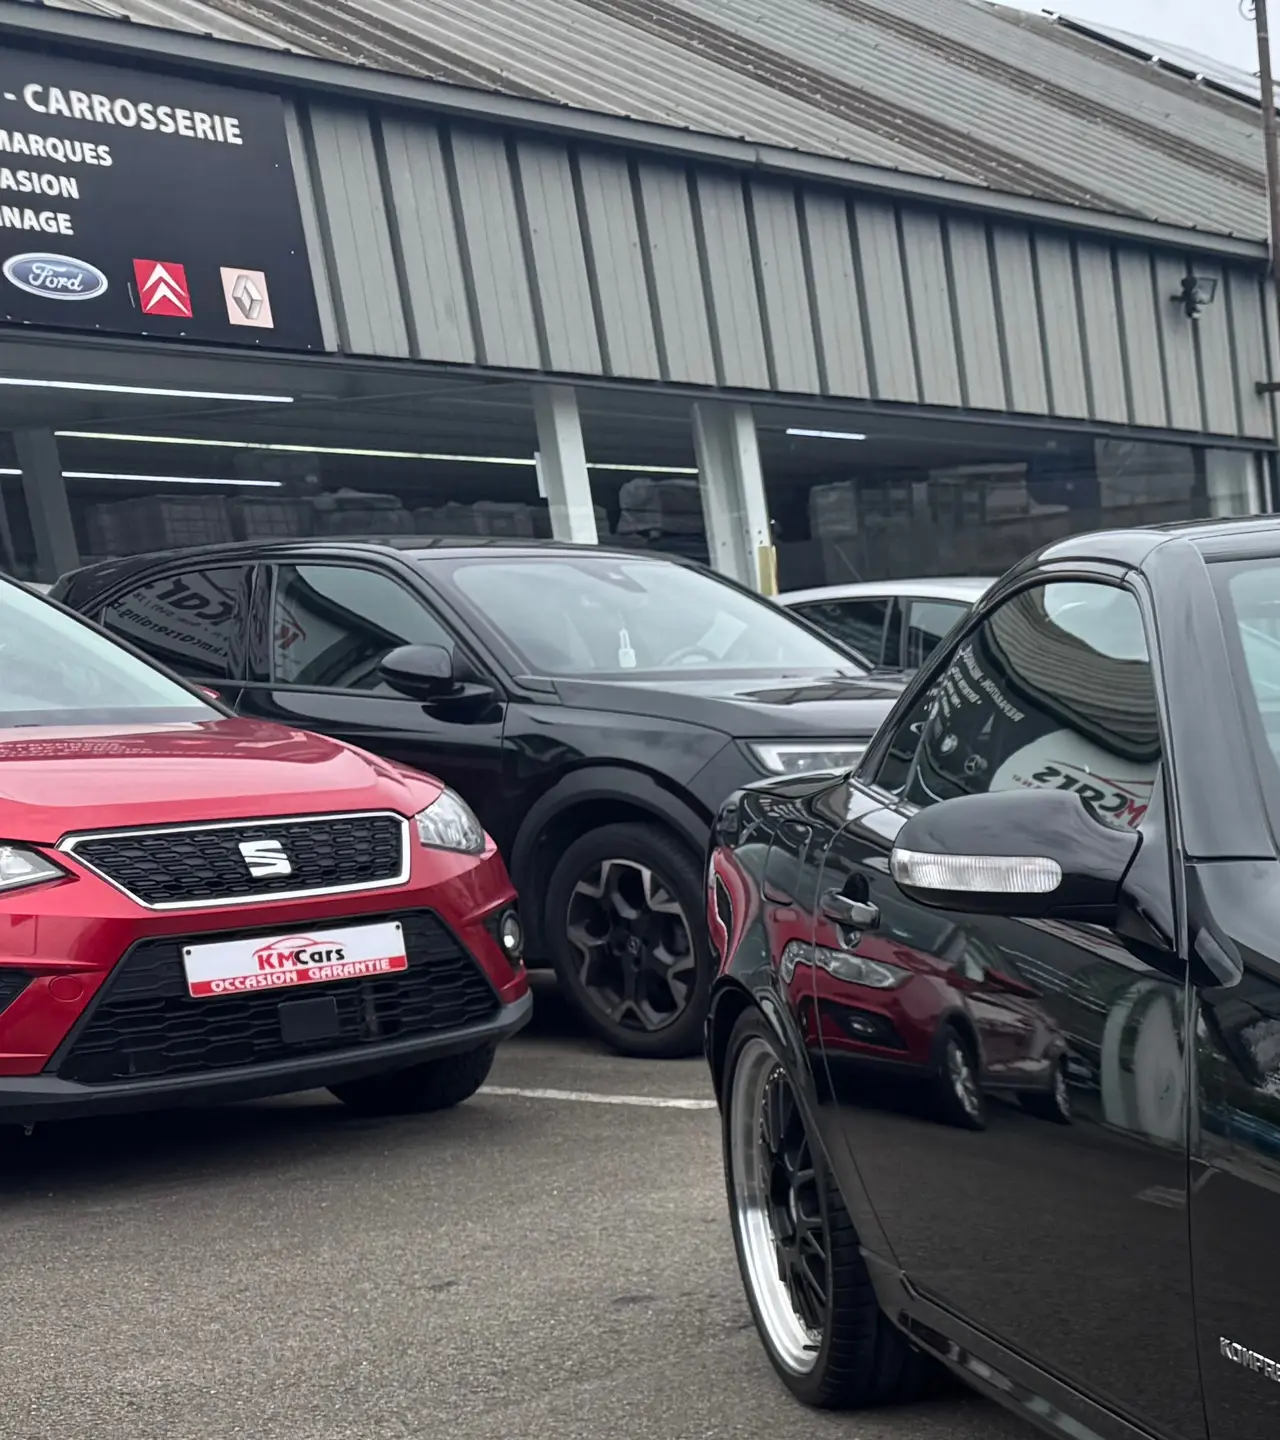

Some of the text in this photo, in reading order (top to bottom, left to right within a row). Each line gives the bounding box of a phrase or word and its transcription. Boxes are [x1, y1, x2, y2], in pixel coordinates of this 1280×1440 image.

[24, 83, 243, 145] CARROSSERIE
[0, 168, 80, 199] ASION
[0, 205, 74, 235] NAGE
[28, 262, 84, 292] Ford
[256, 948, 345, 971] KMCars
[210, 957, 391, 993] OCCASION GARANTIE
